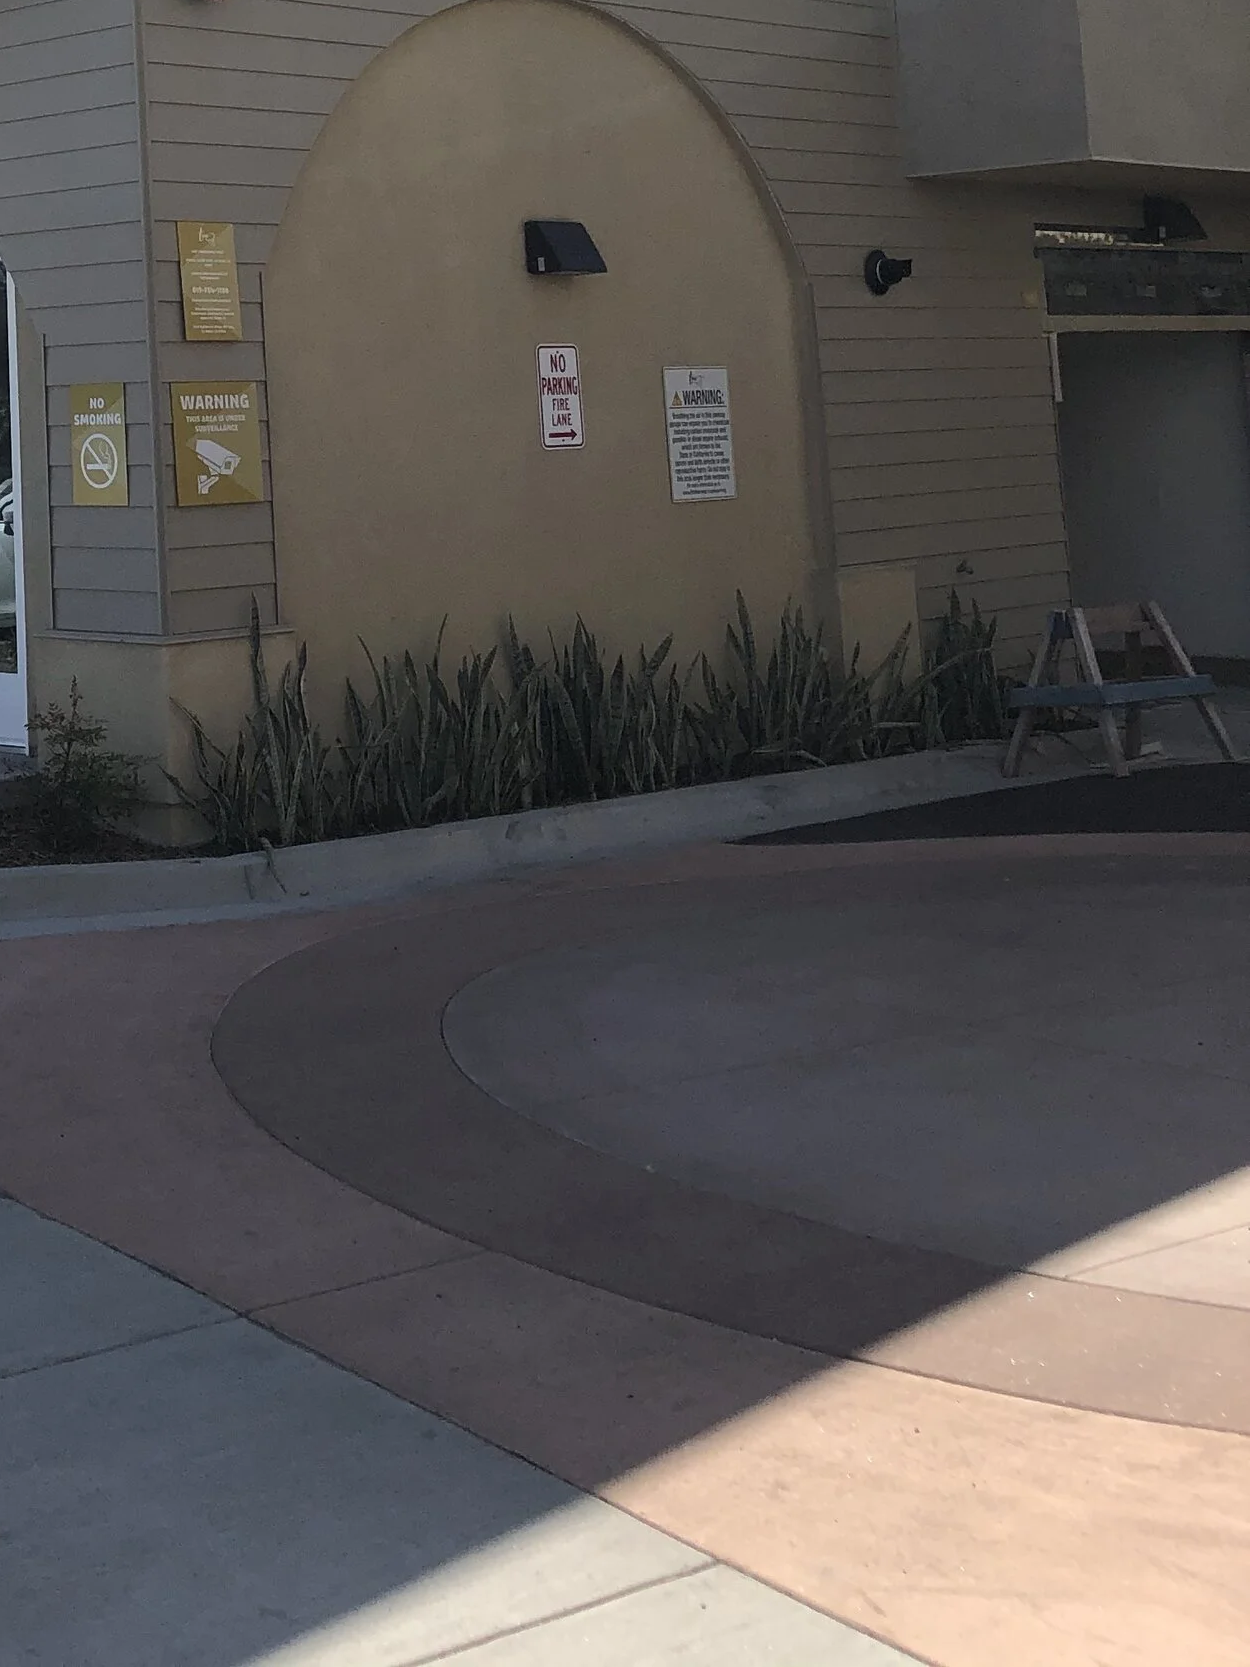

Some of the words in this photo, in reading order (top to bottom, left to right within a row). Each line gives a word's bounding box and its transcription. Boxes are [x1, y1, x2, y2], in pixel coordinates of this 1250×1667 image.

[550, 353, 566, 373] NO
[541, 376, 578, 395] PARKING
[89, 397, 105, 409] NO
[179, 394, 250, 410] WARNING
[682, 389, 725, 405] WARNING:
[552, 398, 570, 411] FIRE
[73, 412, 122, 426] SMOKING
[185, 415, 200, 423] THIS
[552, 413, 572, 426] LANE
